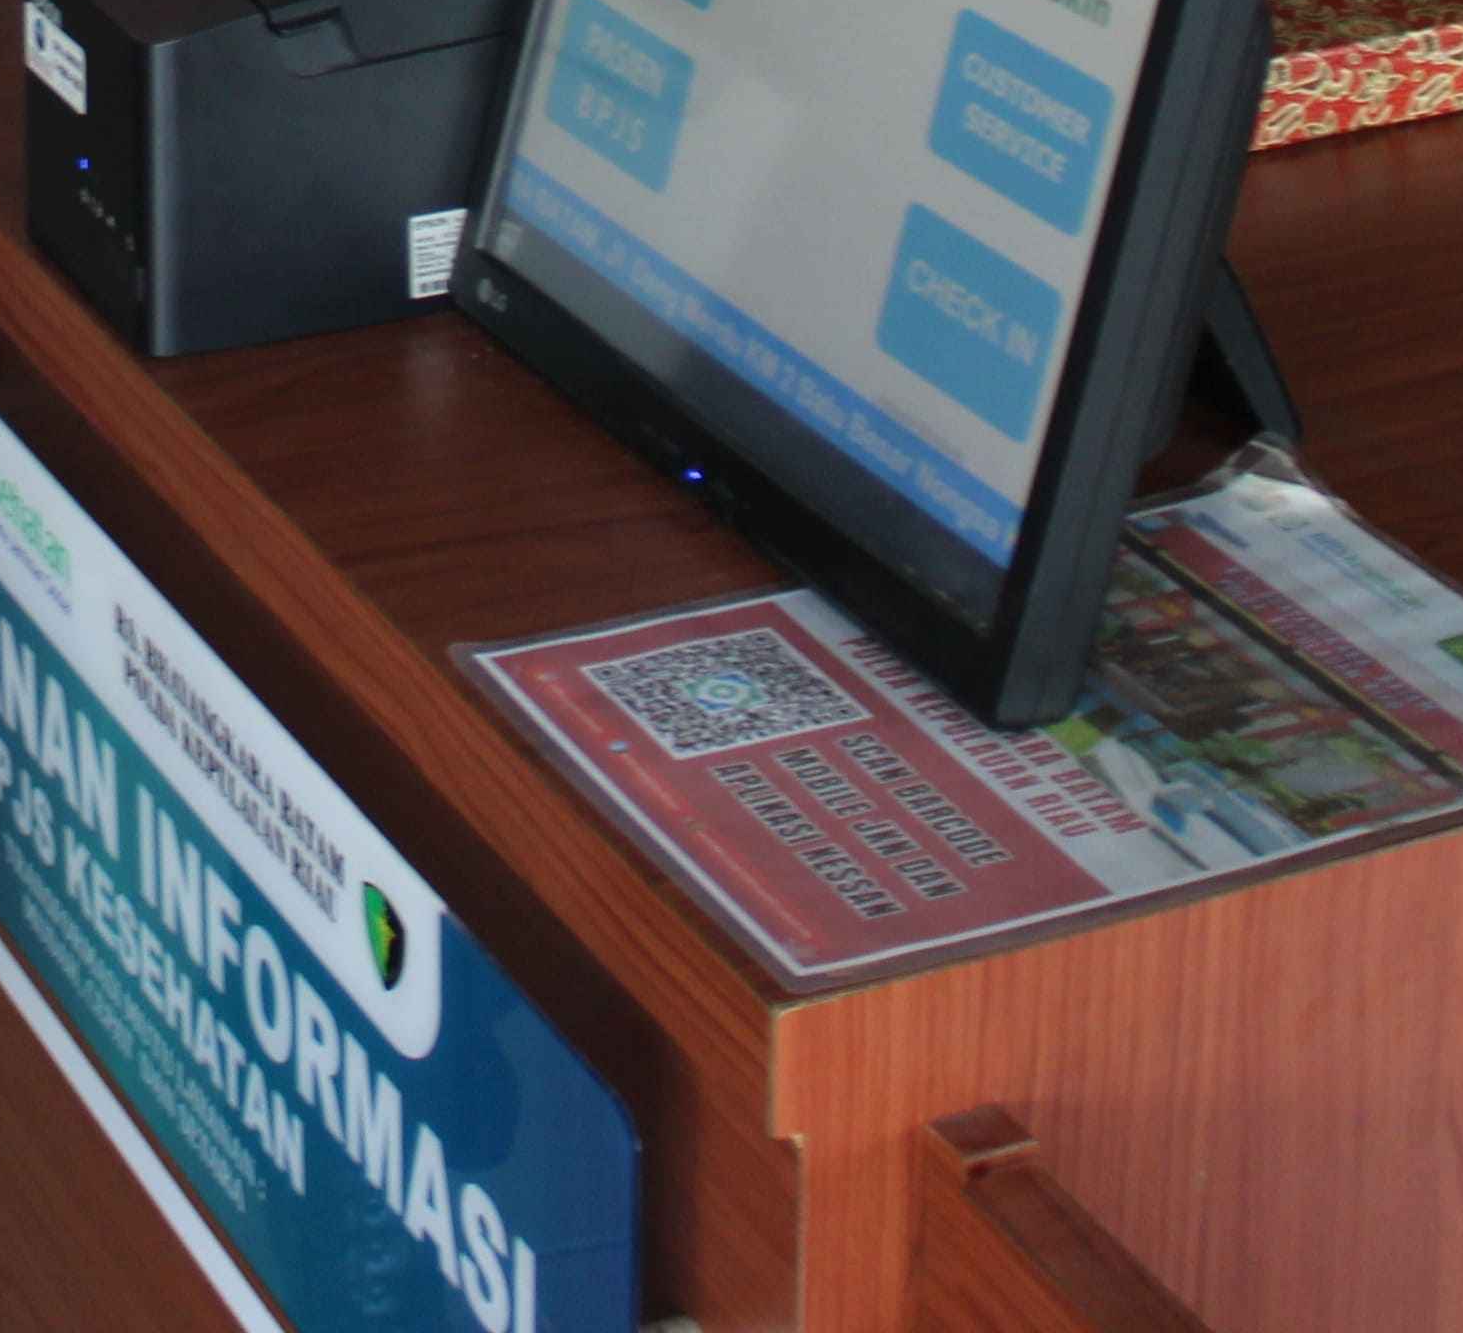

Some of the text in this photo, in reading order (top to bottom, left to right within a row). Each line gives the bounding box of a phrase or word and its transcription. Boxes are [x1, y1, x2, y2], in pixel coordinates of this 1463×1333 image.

[962, 50, 1092, 146] CUSTOMER
[963, 101, 1068, 184] SERVICE
[905, 258, 1004, 348] CHECK
[280, 788, 345, 886] BATAM
[711, 761, 910, 921] APLIKASI KESSAN
[775, 747, 968, 902] MOBILE JKN DAN
[840, 732, 1015, 868] SCAN BARCODE
[1026, 793, 1102, 839] RIAU
[290, 844, 338, 923] RIAU
[65, 823, 308, 1198] KESEHATAN
[135, 789, 538, 1333] INFORMASI
